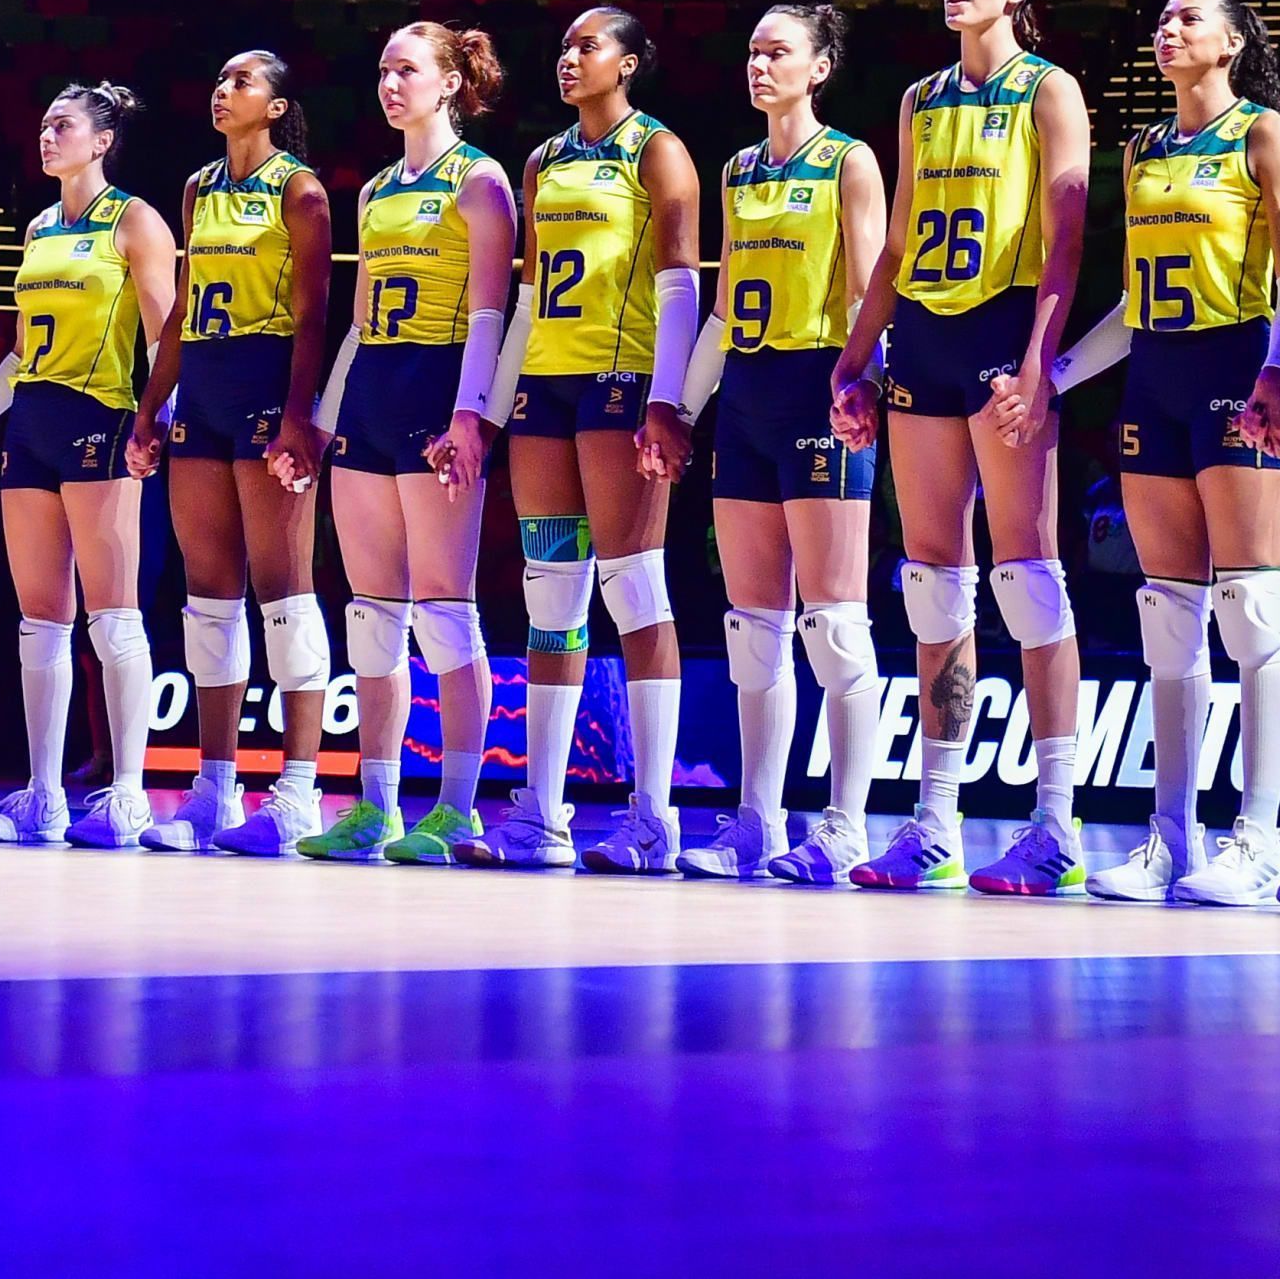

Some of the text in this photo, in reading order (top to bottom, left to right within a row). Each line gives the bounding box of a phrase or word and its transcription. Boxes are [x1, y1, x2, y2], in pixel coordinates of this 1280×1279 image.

[923, 165, 1001, 179] BANCO DO BRASIL
[536, 210, 610, 223] BANCO DO BRASIL
[1129, 211, 1212, 227] BANCO DO BRASIL
[213, 246, 224, 254] DO
[225, 244, 257, 256] BRASIL
[734, 237, 806, 251] BANCO DO BRASIL
[909, 208, 985, 282] 26
[365, 245, 440, 260] BANCO DO BRASIL
[16, 279, 86, 293] BANCO DO BRASIL
[538, 249, 585, 320] 12
[1135, 256, 1196, 331] 15
[192, 282, 233, 339] 16
[369, 277, 418, 338] 17
[731, 279, 772, 349] 9
[597, 371, 636, 383] enel
[512, 393, 528, 420] 2
[1210, 398, 1247, 412] ene
[796, 435, 835, 450] enel
